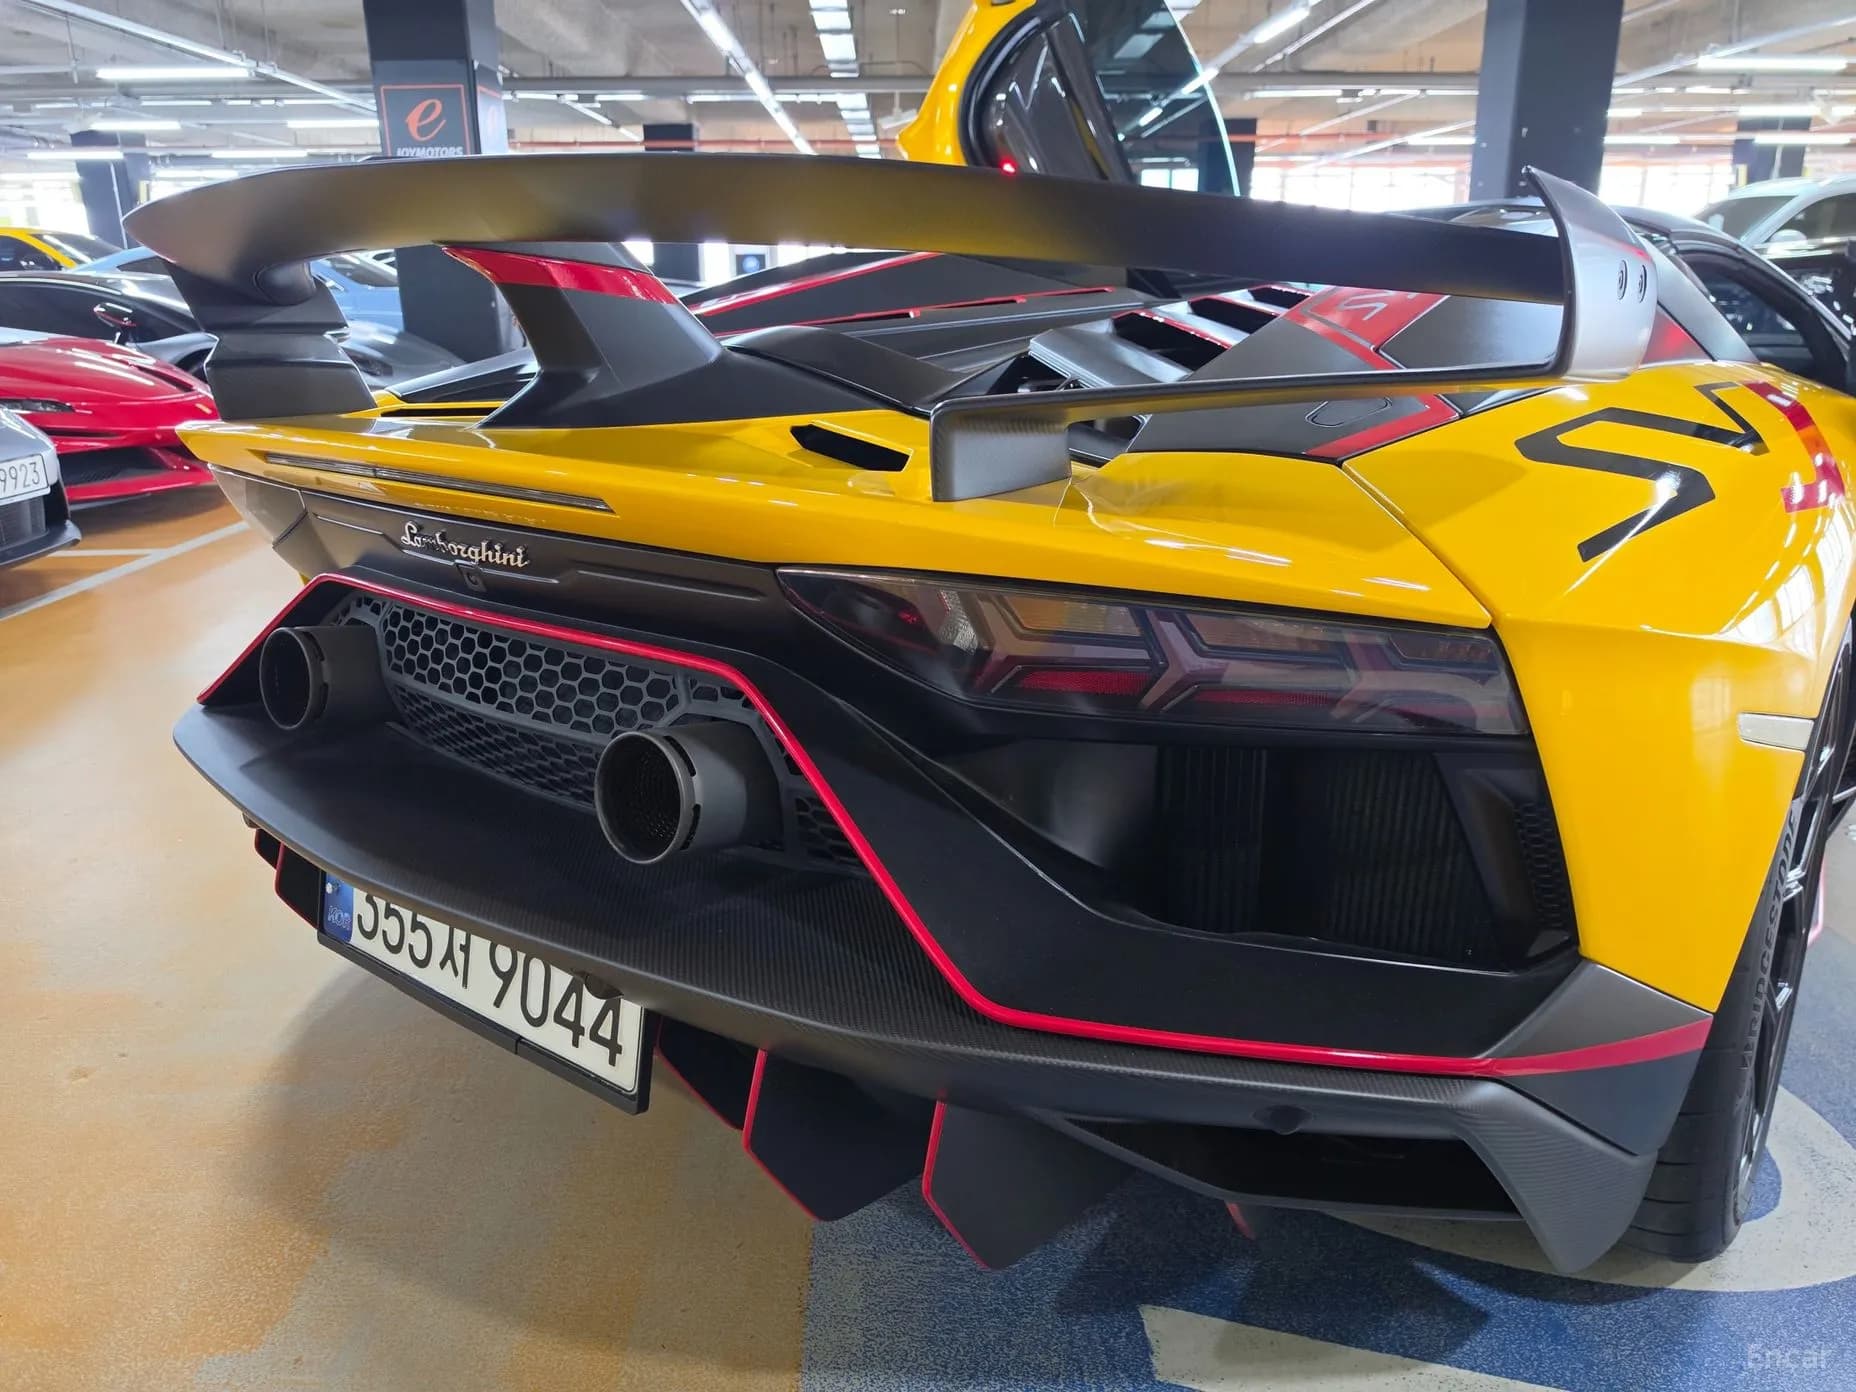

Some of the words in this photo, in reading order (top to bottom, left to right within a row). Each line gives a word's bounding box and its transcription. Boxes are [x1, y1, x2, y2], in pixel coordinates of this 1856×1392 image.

[405, 98, 446, 141] e
[0, 461, 40, 493] 9923
[401, 521, 531, 568] Lamborghini
[489, 941, 623, 1067] 9044
